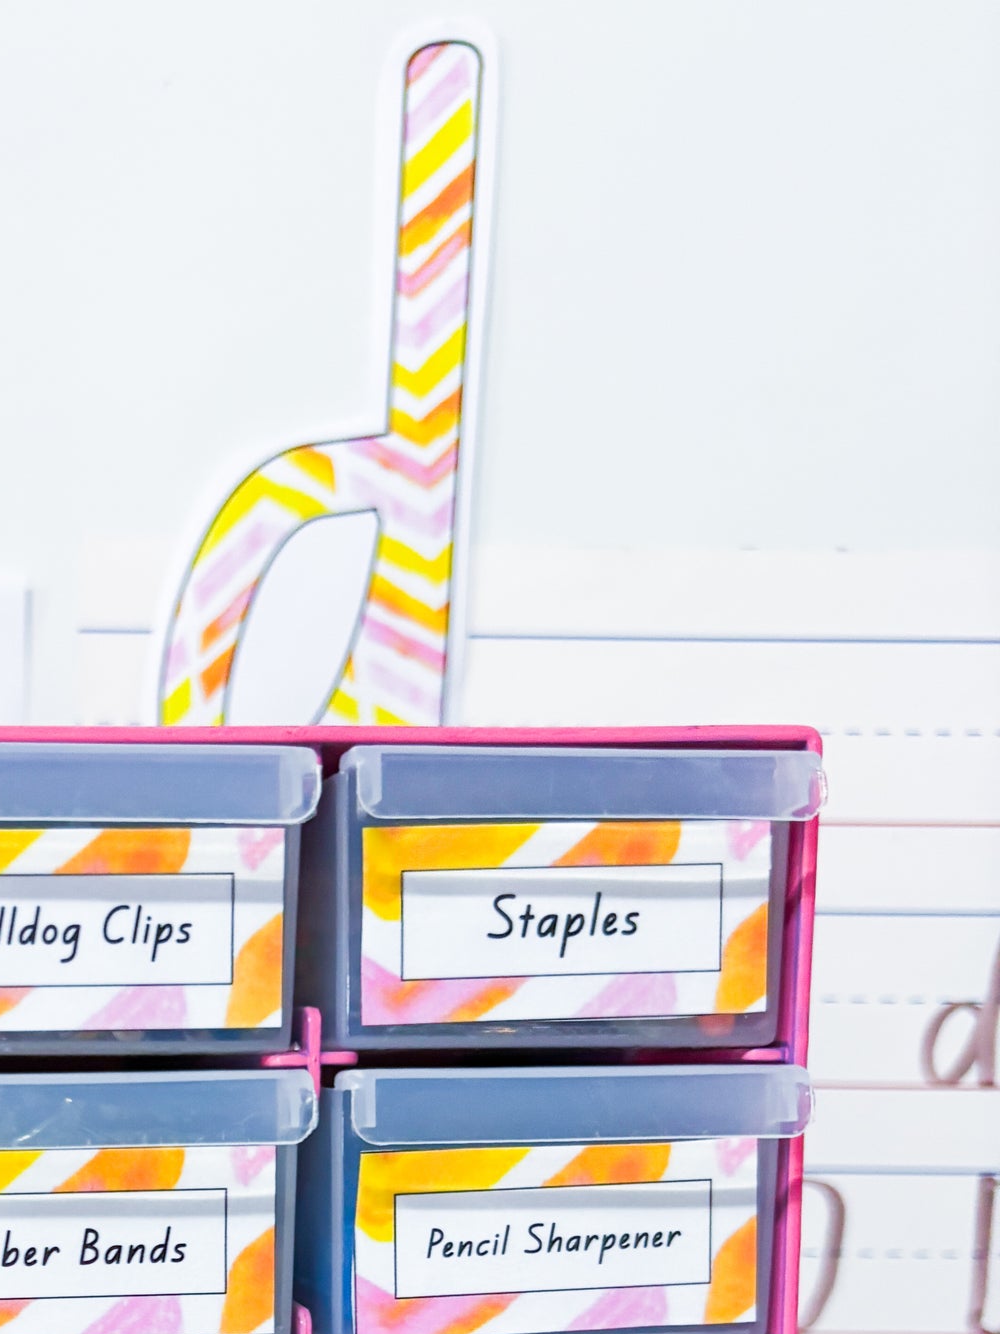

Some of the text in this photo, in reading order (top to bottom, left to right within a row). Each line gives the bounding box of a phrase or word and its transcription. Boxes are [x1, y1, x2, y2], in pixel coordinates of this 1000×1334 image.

[102, 904, 193, 963] Clips
[486, 891, 640, 959] Staples
[79, 1225, 187, 1266] Bands
[426, 1222, 682, 1265] Pencil Sharpener
